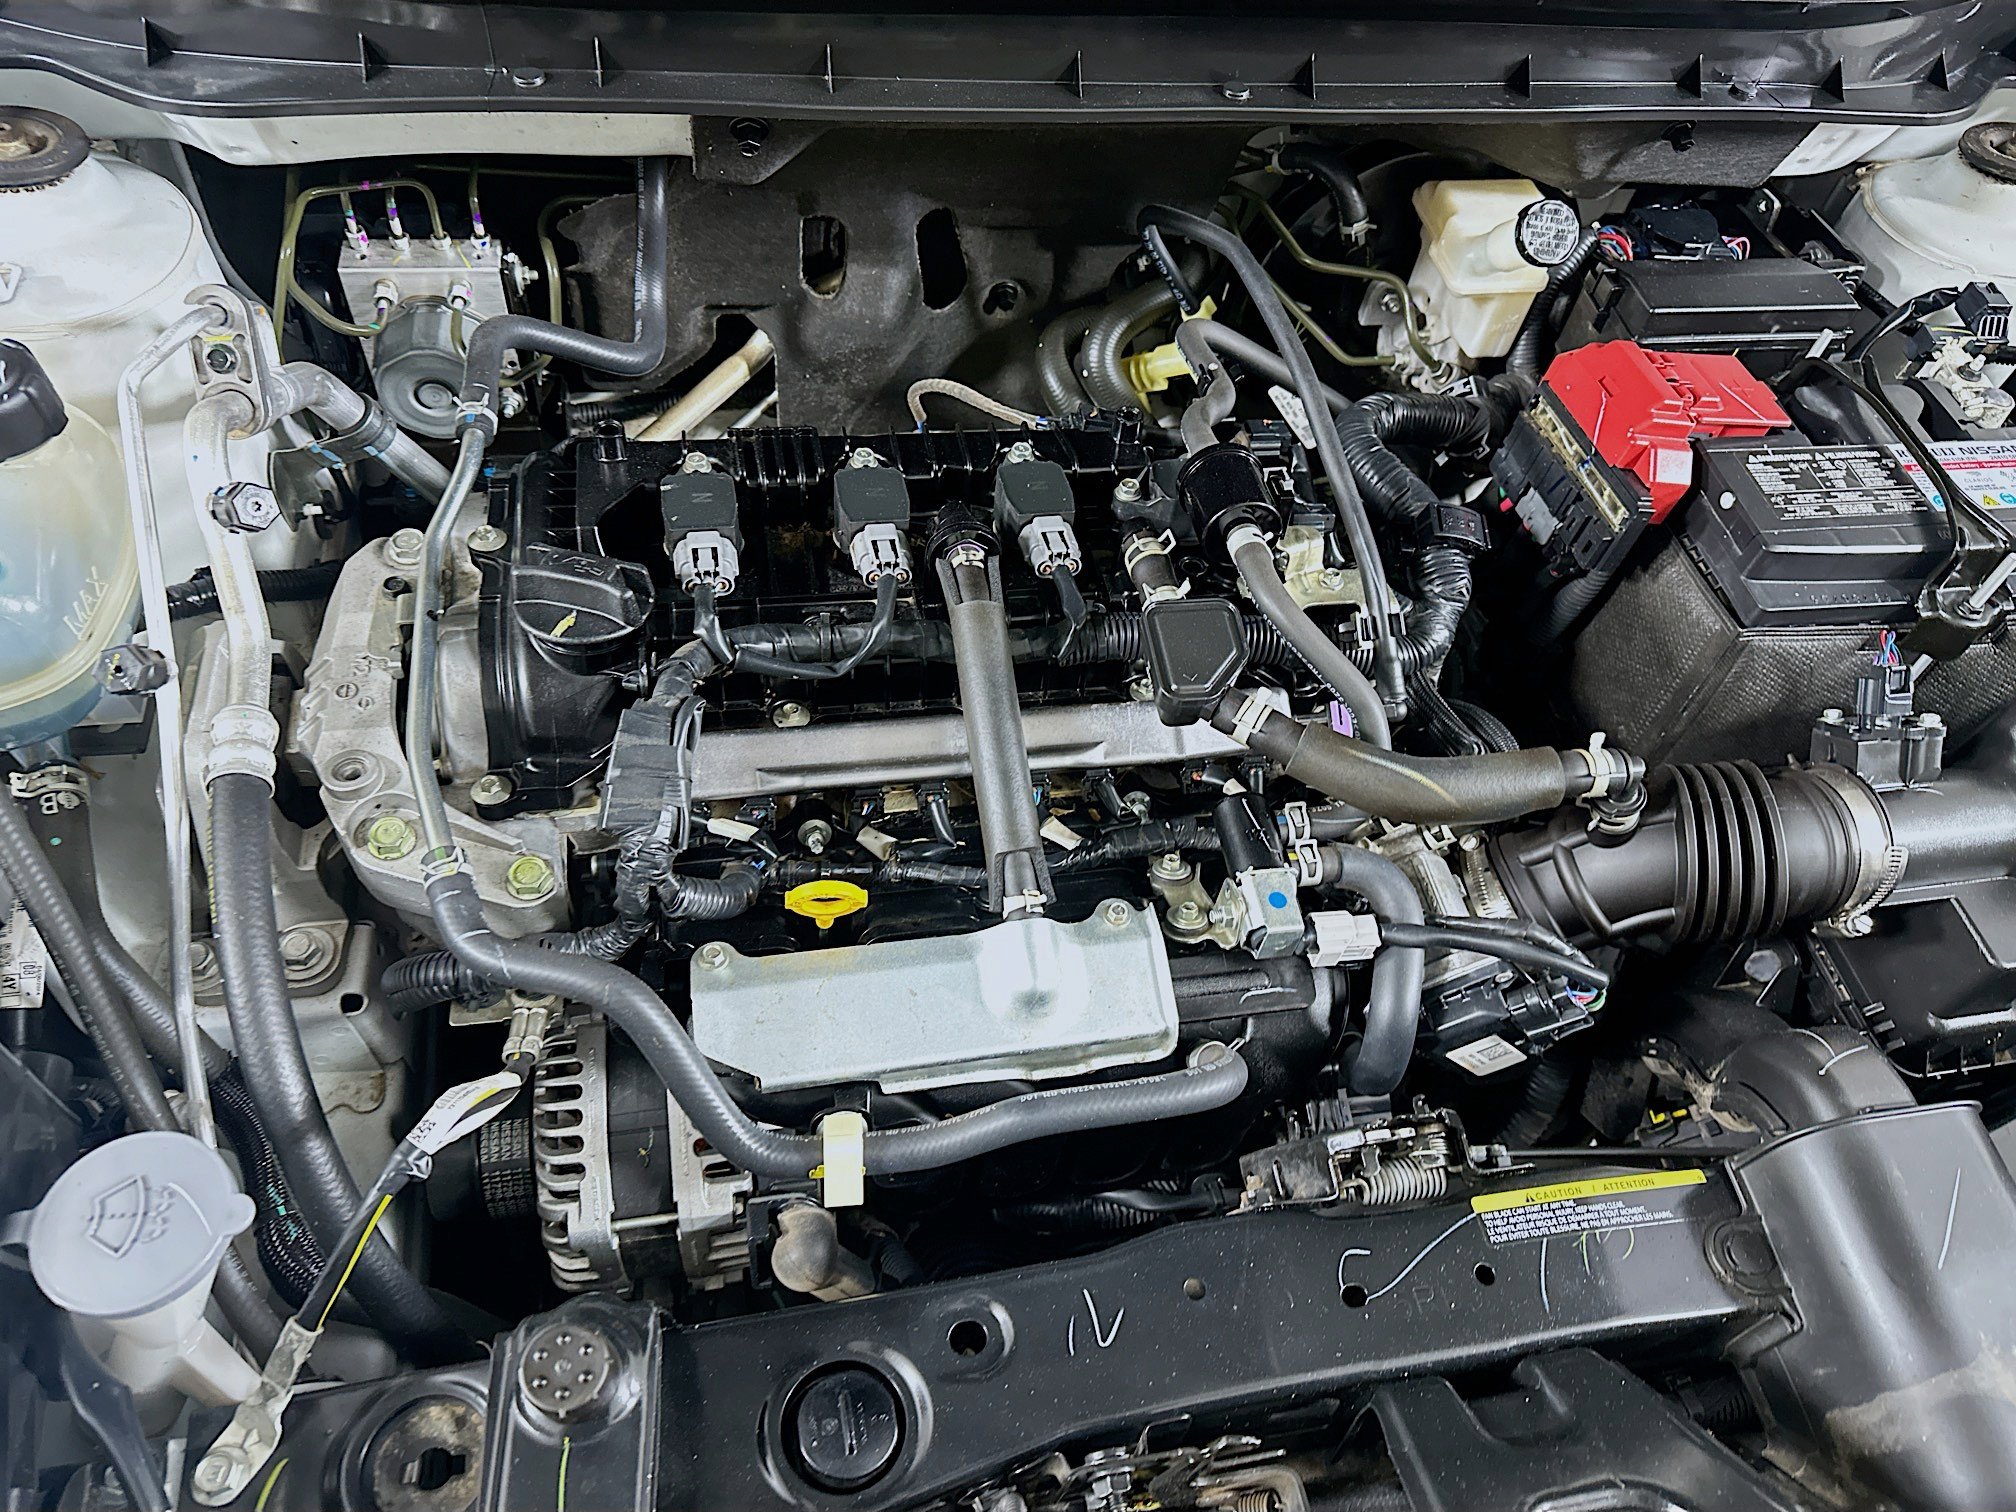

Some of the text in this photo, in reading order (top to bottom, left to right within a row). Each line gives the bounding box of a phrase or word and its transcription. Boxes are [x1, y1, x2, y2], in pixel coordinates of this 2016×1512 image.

[501, 1119, 512, 1161] NISSAN
[1535, 1186, 1582, 1200] CAUTION
[1603, 1178, 1655, 1192] ATTENTION
